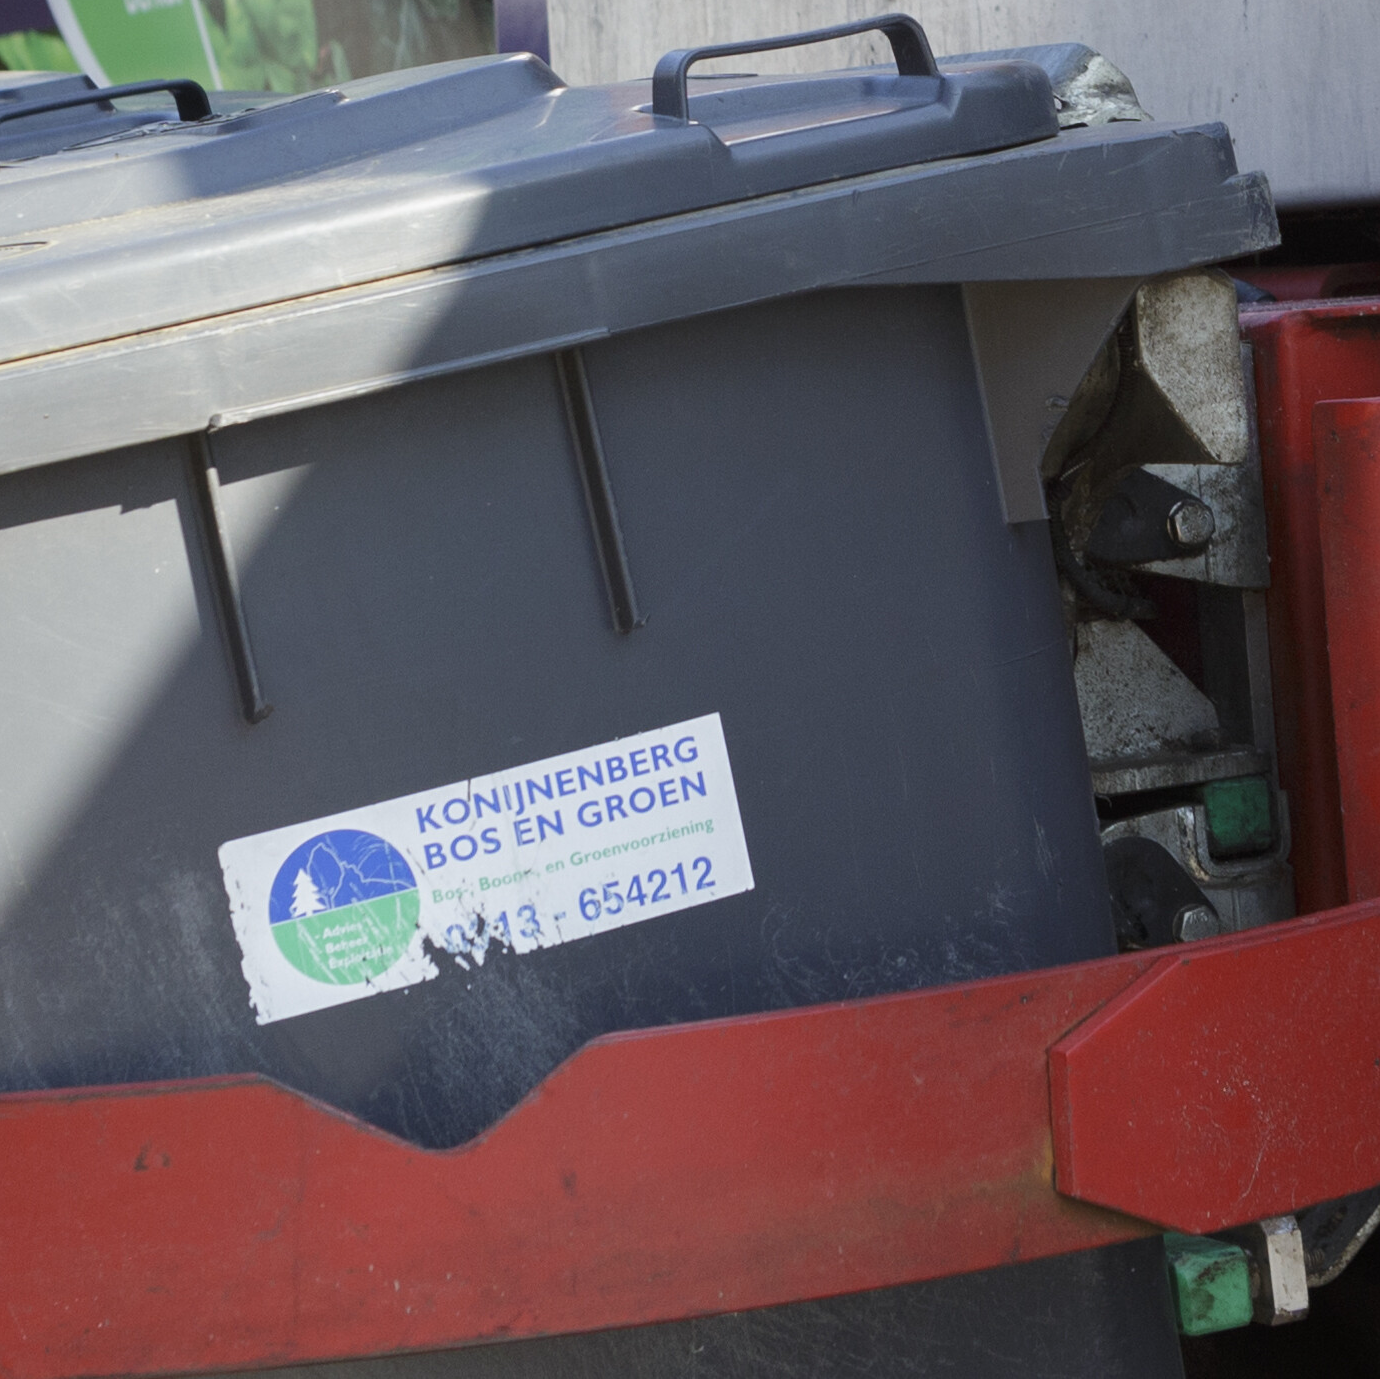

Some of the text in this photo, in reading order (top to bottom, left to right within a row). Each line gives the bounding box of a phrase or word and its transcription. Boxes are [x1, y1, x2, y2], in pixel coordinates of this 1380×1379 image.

[415, 735, 700, 835] KONIJNENBERG
[423, 771, 708, 871] BOS EN GROEN
[545, 859, 566, 875] en
[569, 818, 715, 868] Groenvoorziening
[578, 856, 717, 922] 654212
